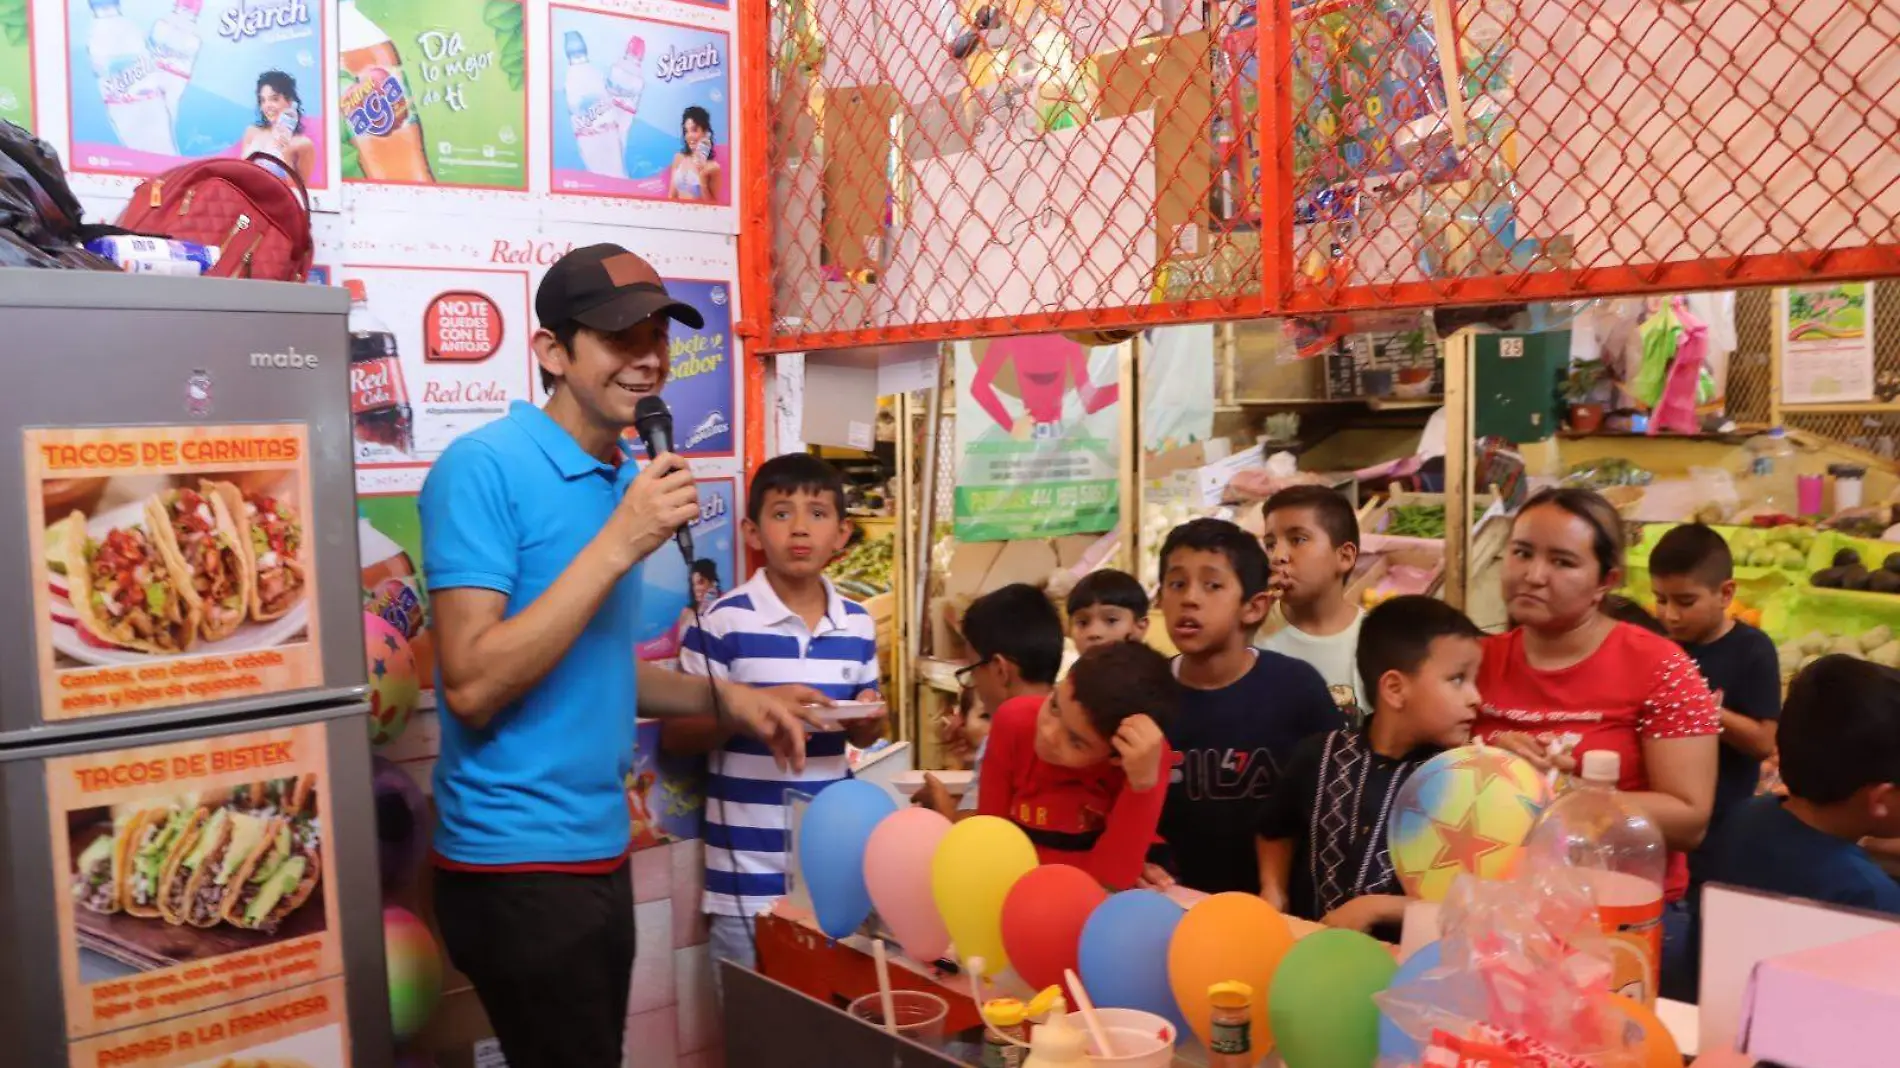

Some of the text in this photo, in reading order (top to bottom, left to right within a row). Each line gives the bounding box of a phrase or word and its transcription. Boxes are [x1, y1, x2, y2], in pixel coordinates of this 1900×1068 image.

[218, 0, 310, 42] Skarch
[417, 31, 467, 61] Da
[420, 51, 494, 83] lo mejor
[656, 42, 720, 82] Skarch
[488, 239, 535, 265] Red
[438, 300, 488, 317] NO TE
[438, 317, 489, 329] QUEDES
[439, 328, 489, 341] CON EL
[250, 347, 319, 368] mabe
[440, 341, 492, 352] ANTOJO
[351, 363, 389, 393] Red
[360, 388, 390, 406] Cola
[421, 380, 507, 403] Red Cola
[42, 437, 299, 470] TACOS DE CARNITAS
[75, 741, 295, 792] TACOS DE BISTEK
[1221, 748, 1249, 772] 47
[96, 994, 329, 1068] PAPAS A LA FRANCESA
